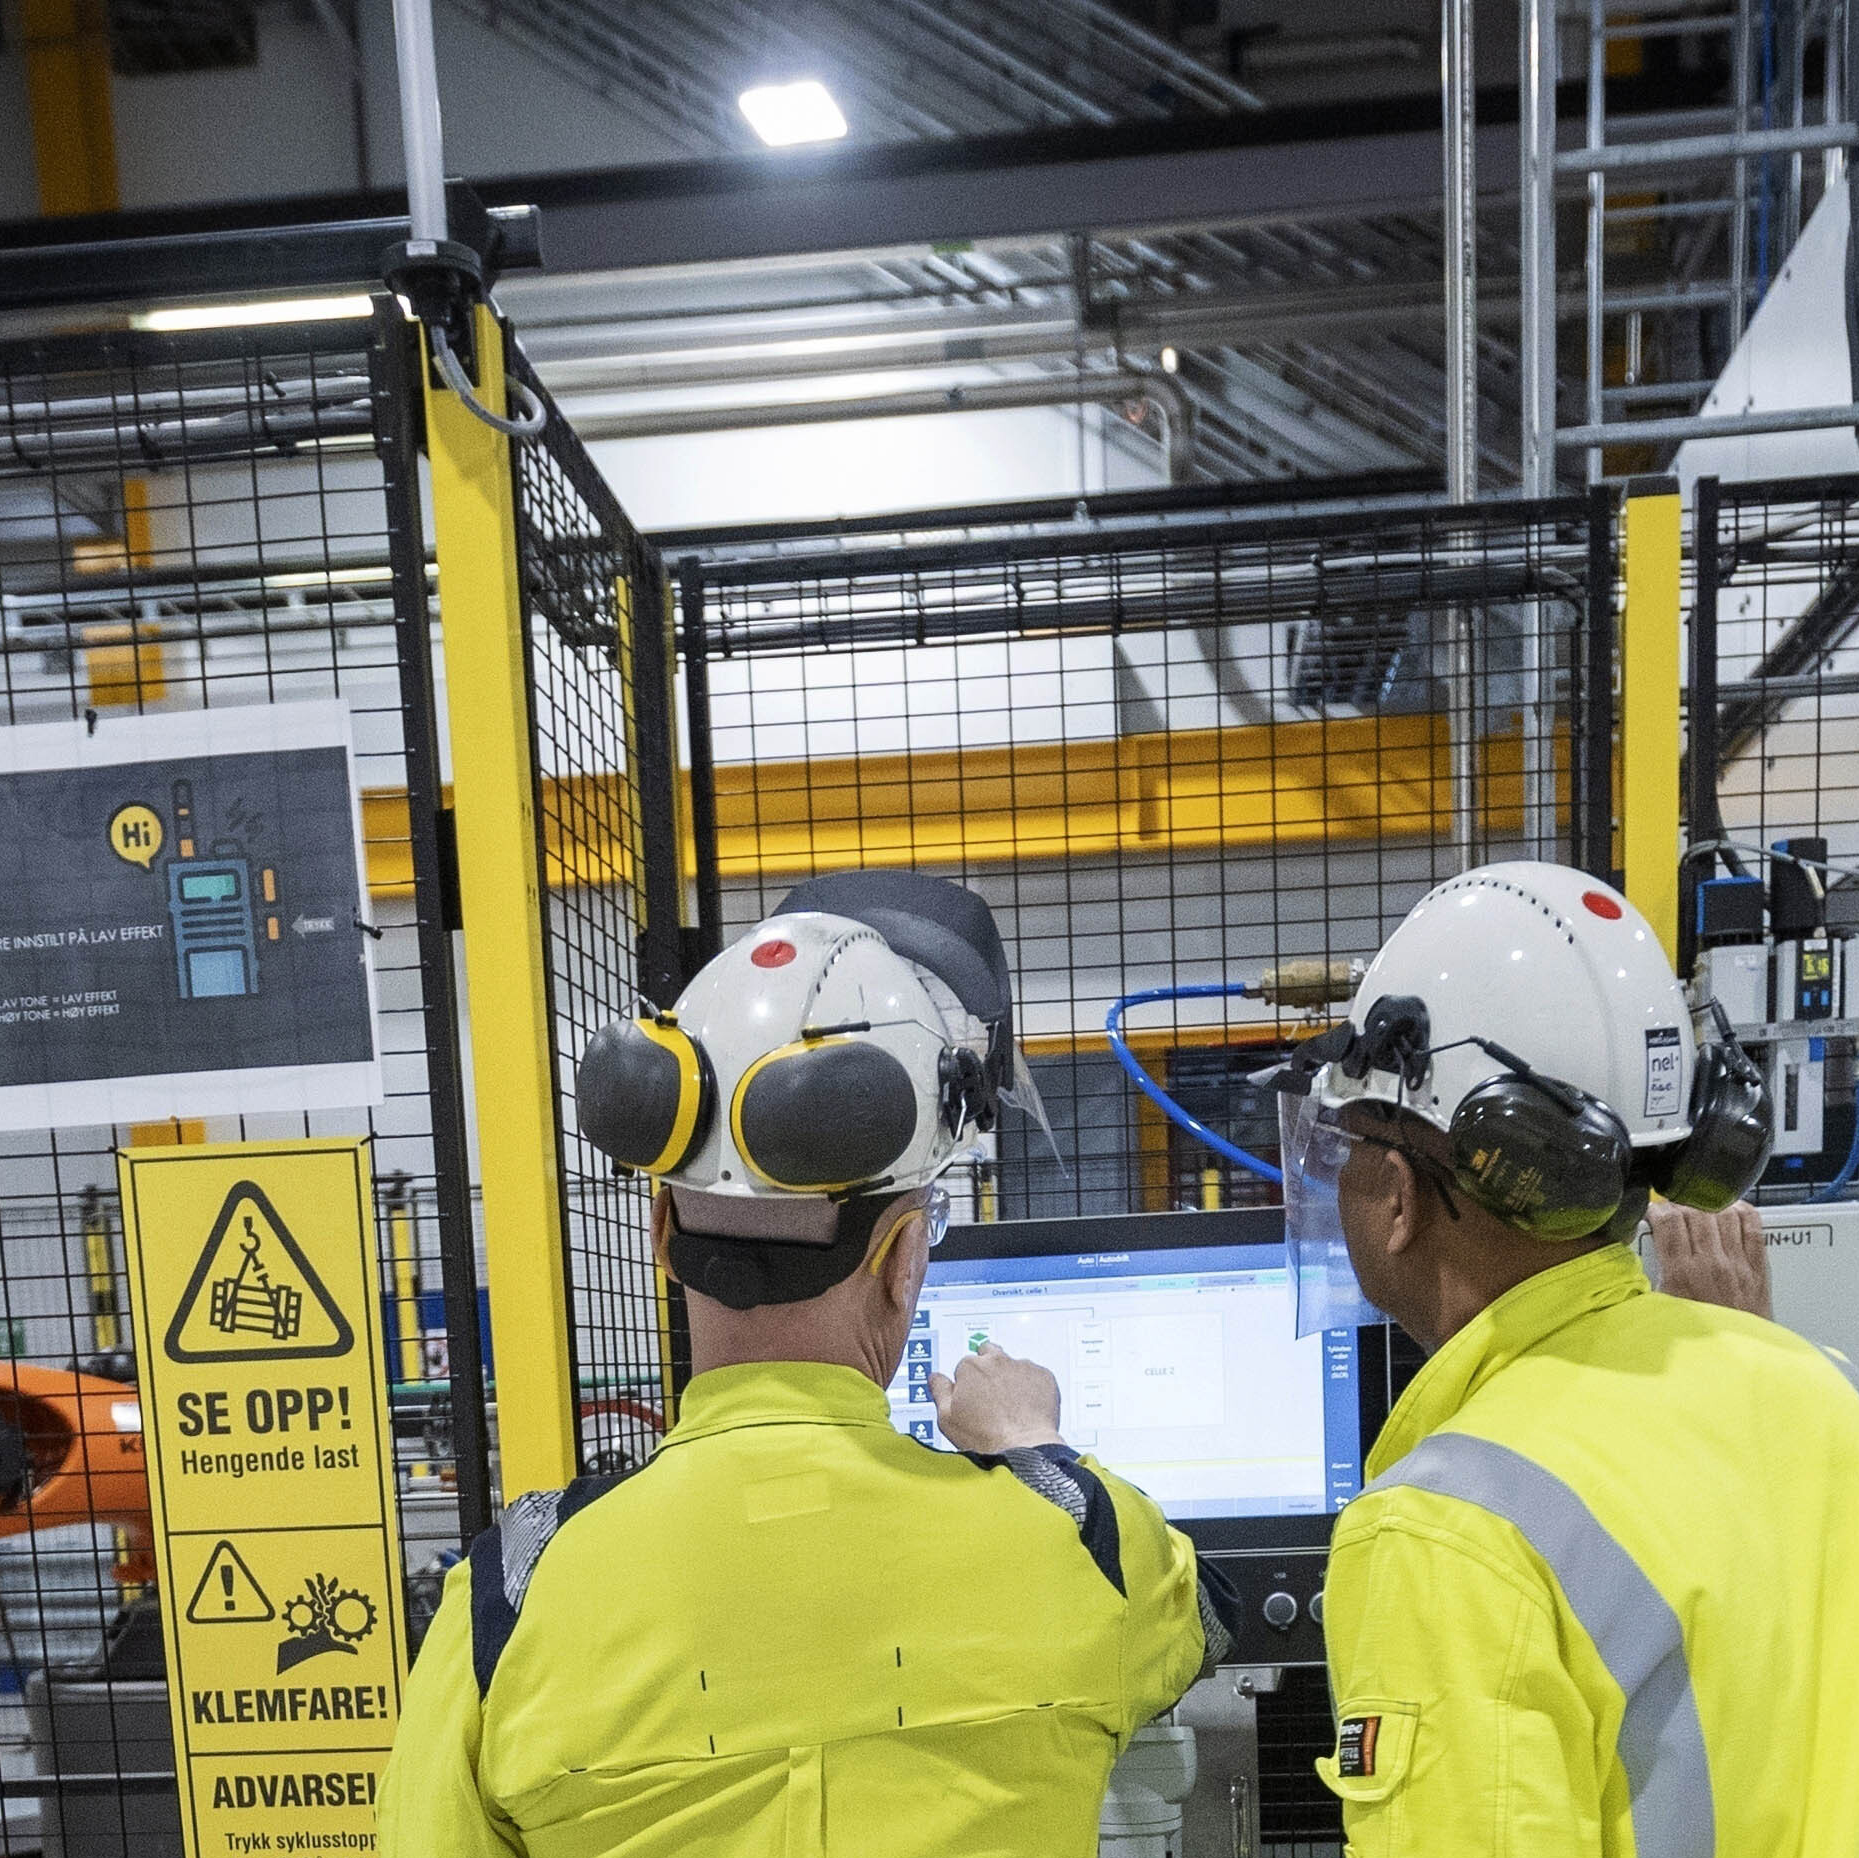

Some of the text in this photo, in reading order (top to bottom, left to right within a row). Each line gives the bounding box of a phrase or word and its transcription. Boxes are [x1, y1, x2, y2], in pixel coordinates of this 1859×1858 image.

[121, 821, 151, 848] Hi
[13, 931, 65, 949] INNSTILT
[68, 927, 88, 945] PÅ
[91, 928, 117, 944] LAV
[120, 924, 164, 940] EFFEKT
[19, 995, 48, 1008] TONE
[61, 992, 83, 1004] LAV
[84, 989, 118, 1002] EFFEKT
[22, 1008, 51, 1020] TONE
[61, 1005, 86, 1018] HØY
[87, 1002, 120, 1015] EFFEKT
[1651, 1052, 1674, 1072] nel
[1765, 1230, 1811, 1246] IN+U1
[1077, 1255, 1094, 1265] Auto
[1144, 1367, 1167, 1377] CELLE
[177, 1386, 351, 1437] SE OPP!
[181, 1444, 359, 1478] Hengende last
[192, 1685, 387, 1724] KLEMFARE!
[225, 1832, 271, 1854] Trykk
